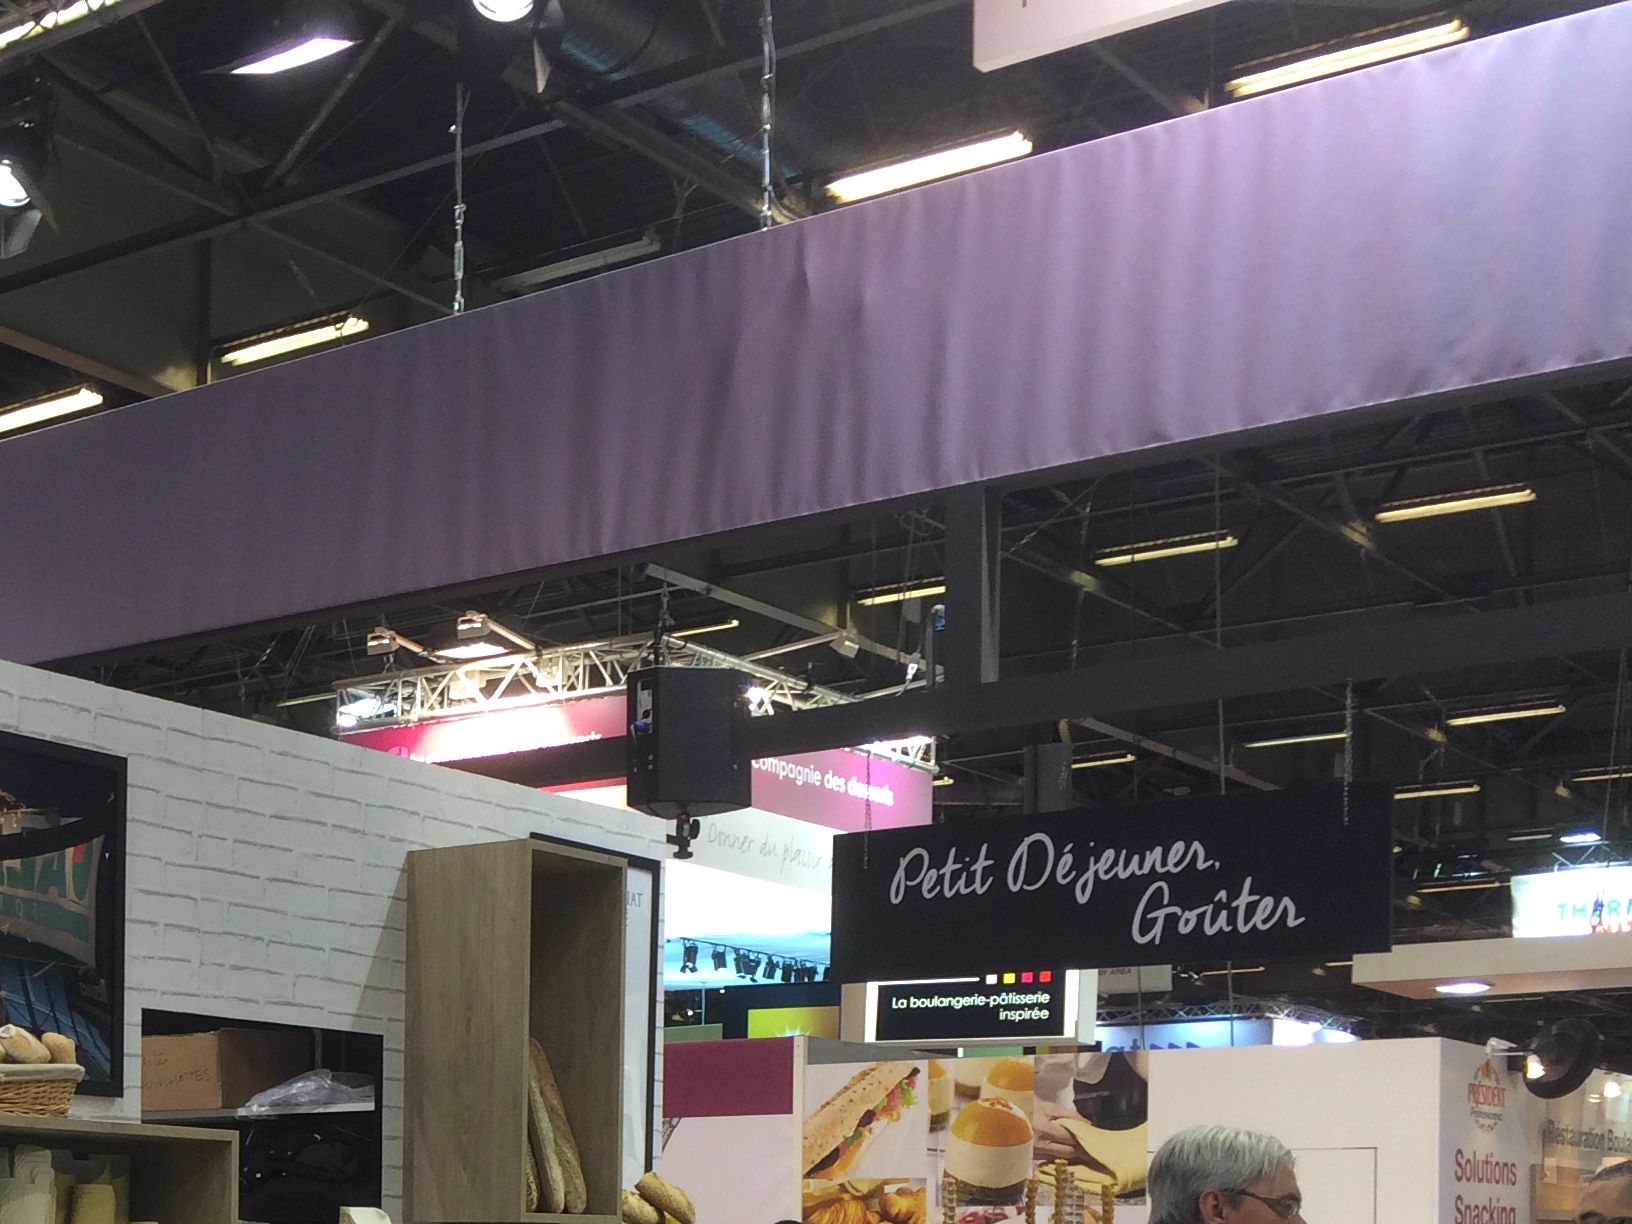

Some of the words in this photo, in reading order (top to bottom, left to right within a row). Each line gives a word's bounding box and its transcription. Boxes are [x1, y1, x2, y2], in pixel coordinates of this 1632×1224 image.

[824, 769, 846, 793] des
[889, 841, 996, 905] Petit
[1007, 832, 1221, 904] Déjeuner,
[1131, 875, 1306, 945] Goûter
[892, 997, 907, 1009] La
[909, 991, 1051, 1009] boulangerie-pâtisserie
[999, 1007, 1050, 1022] inspirée
[1454, 1148, 1517, 1187] Solutions
